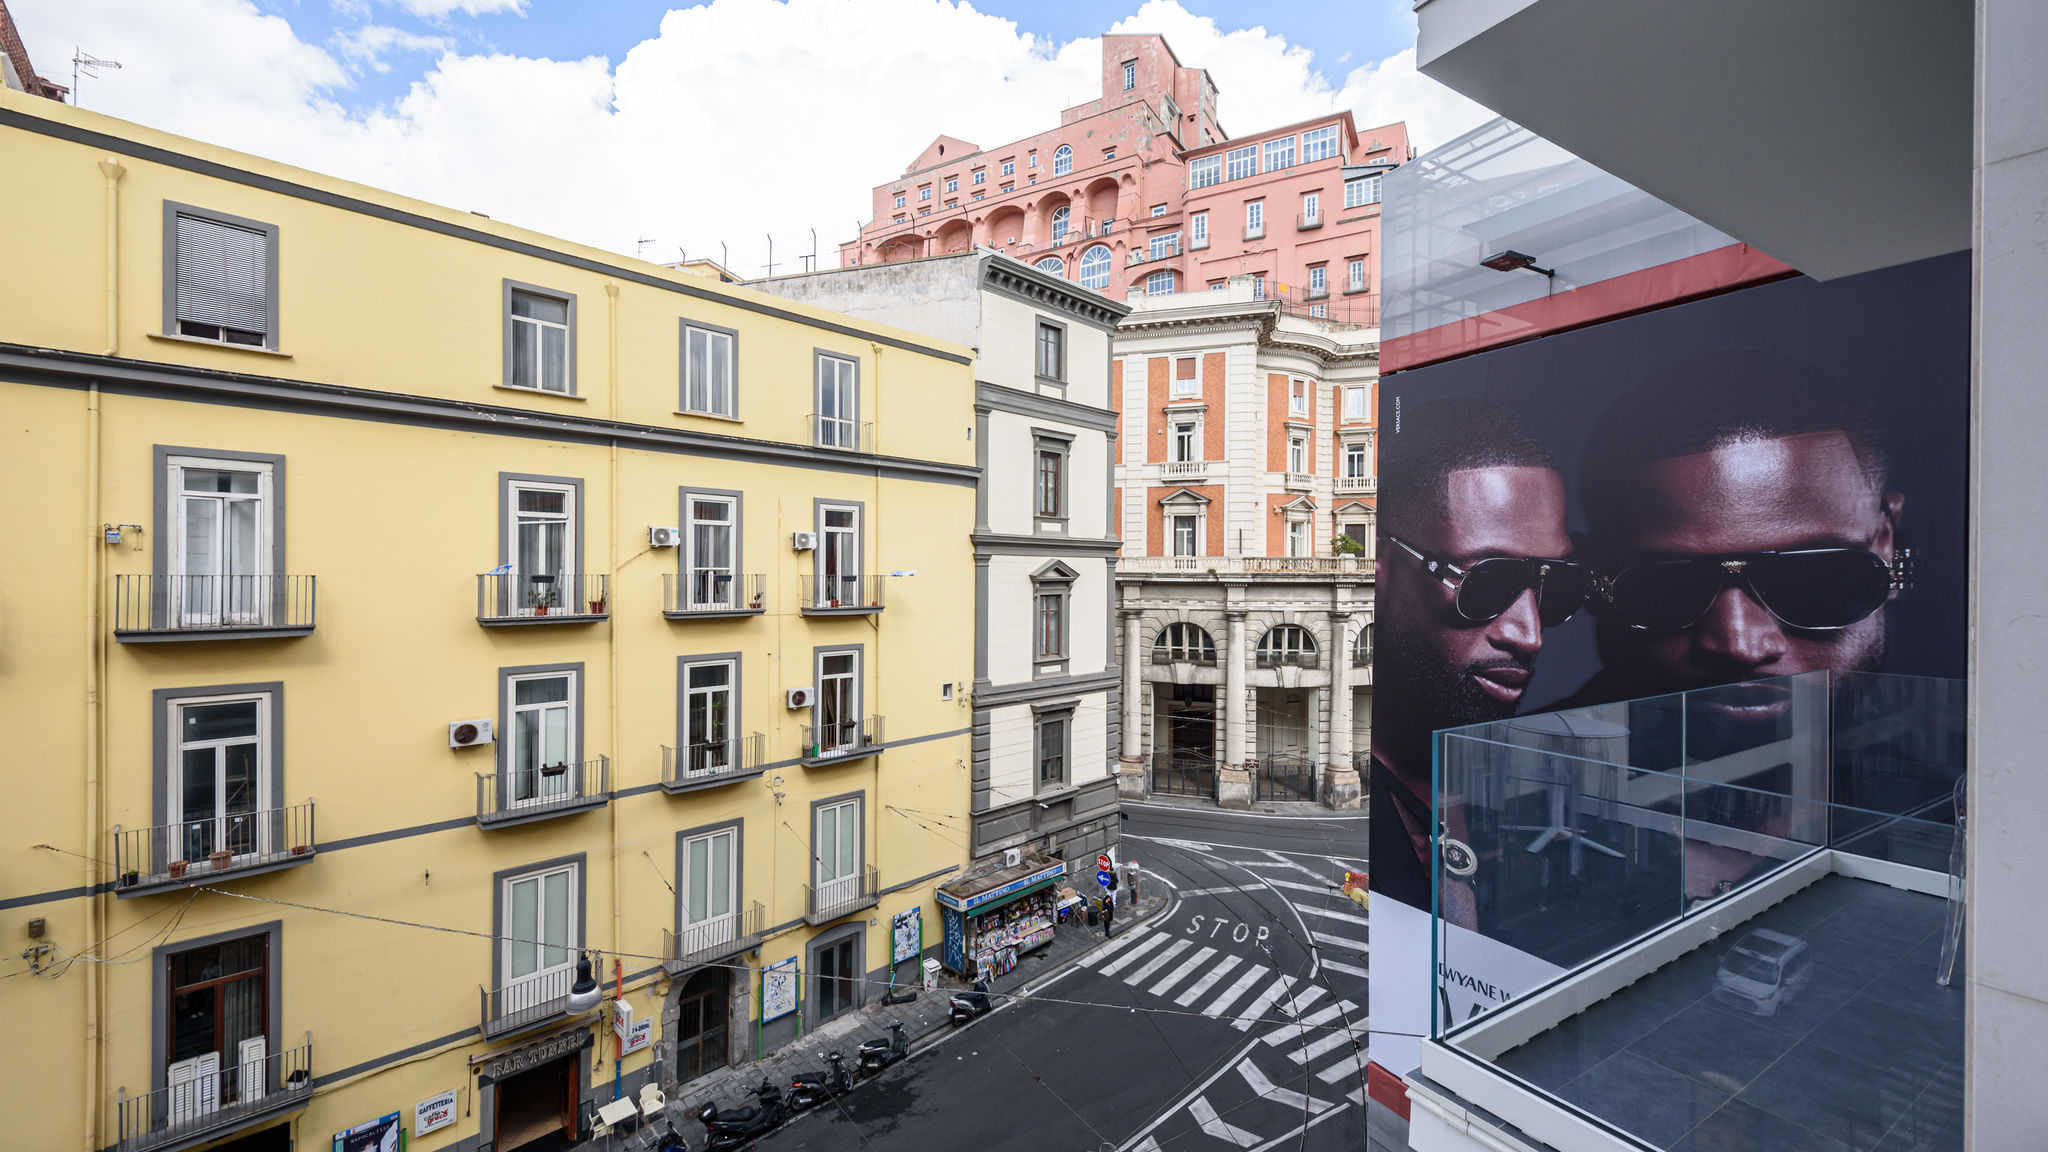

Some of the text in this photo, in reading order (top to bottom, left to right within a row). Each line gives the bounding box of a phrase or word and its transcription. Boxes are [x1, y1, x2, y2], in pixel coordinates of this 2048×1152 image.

[1097, 858, 1110, 868] STOP
[1031, 868, 1057, 883] MATTINO
[973, 893, 981, 905] IL
[981, 886, 1011, 902] MATTINO
[1186, 914, 1270, 947] STOP
[1438, 962, 1497, 1000] DWYANE
[492, 1032, 585, 1078] BAR TUNNEL
[419, 1098, 454, 1115] CAFFETTERIA
